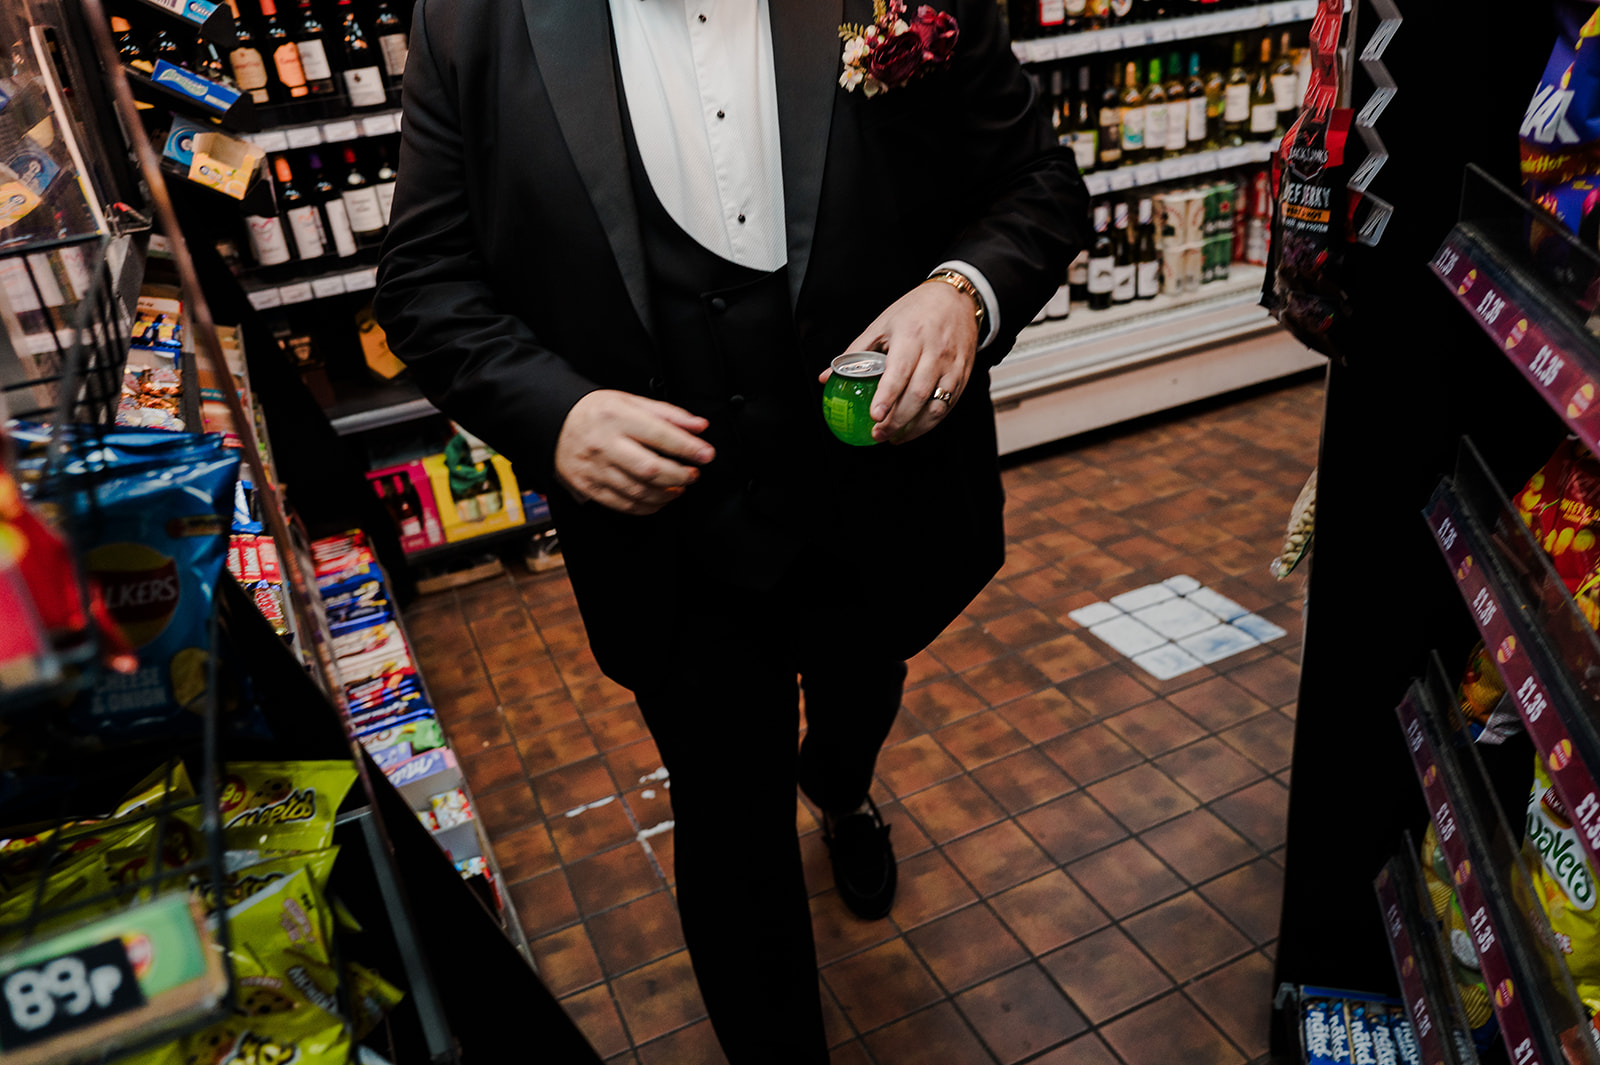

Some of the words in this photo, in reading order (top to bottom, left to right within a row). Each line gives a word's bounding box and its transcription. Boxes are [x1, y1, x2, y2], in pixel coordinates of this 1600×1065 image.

[1475, 289, 1505, 325] £1.35
[1528, 345, 1565, 387] £1.35
[1472, 587, 1498, 627] £1.35
[1516, 675, 1548, 724] £1.35
[1435, 802, 1456, 843] £1.35
[1470, 906, 1496, 954] £1.35
[3, 956, 122, 1032] 89p
[1413, 998, 1433, 1039] £1.35
